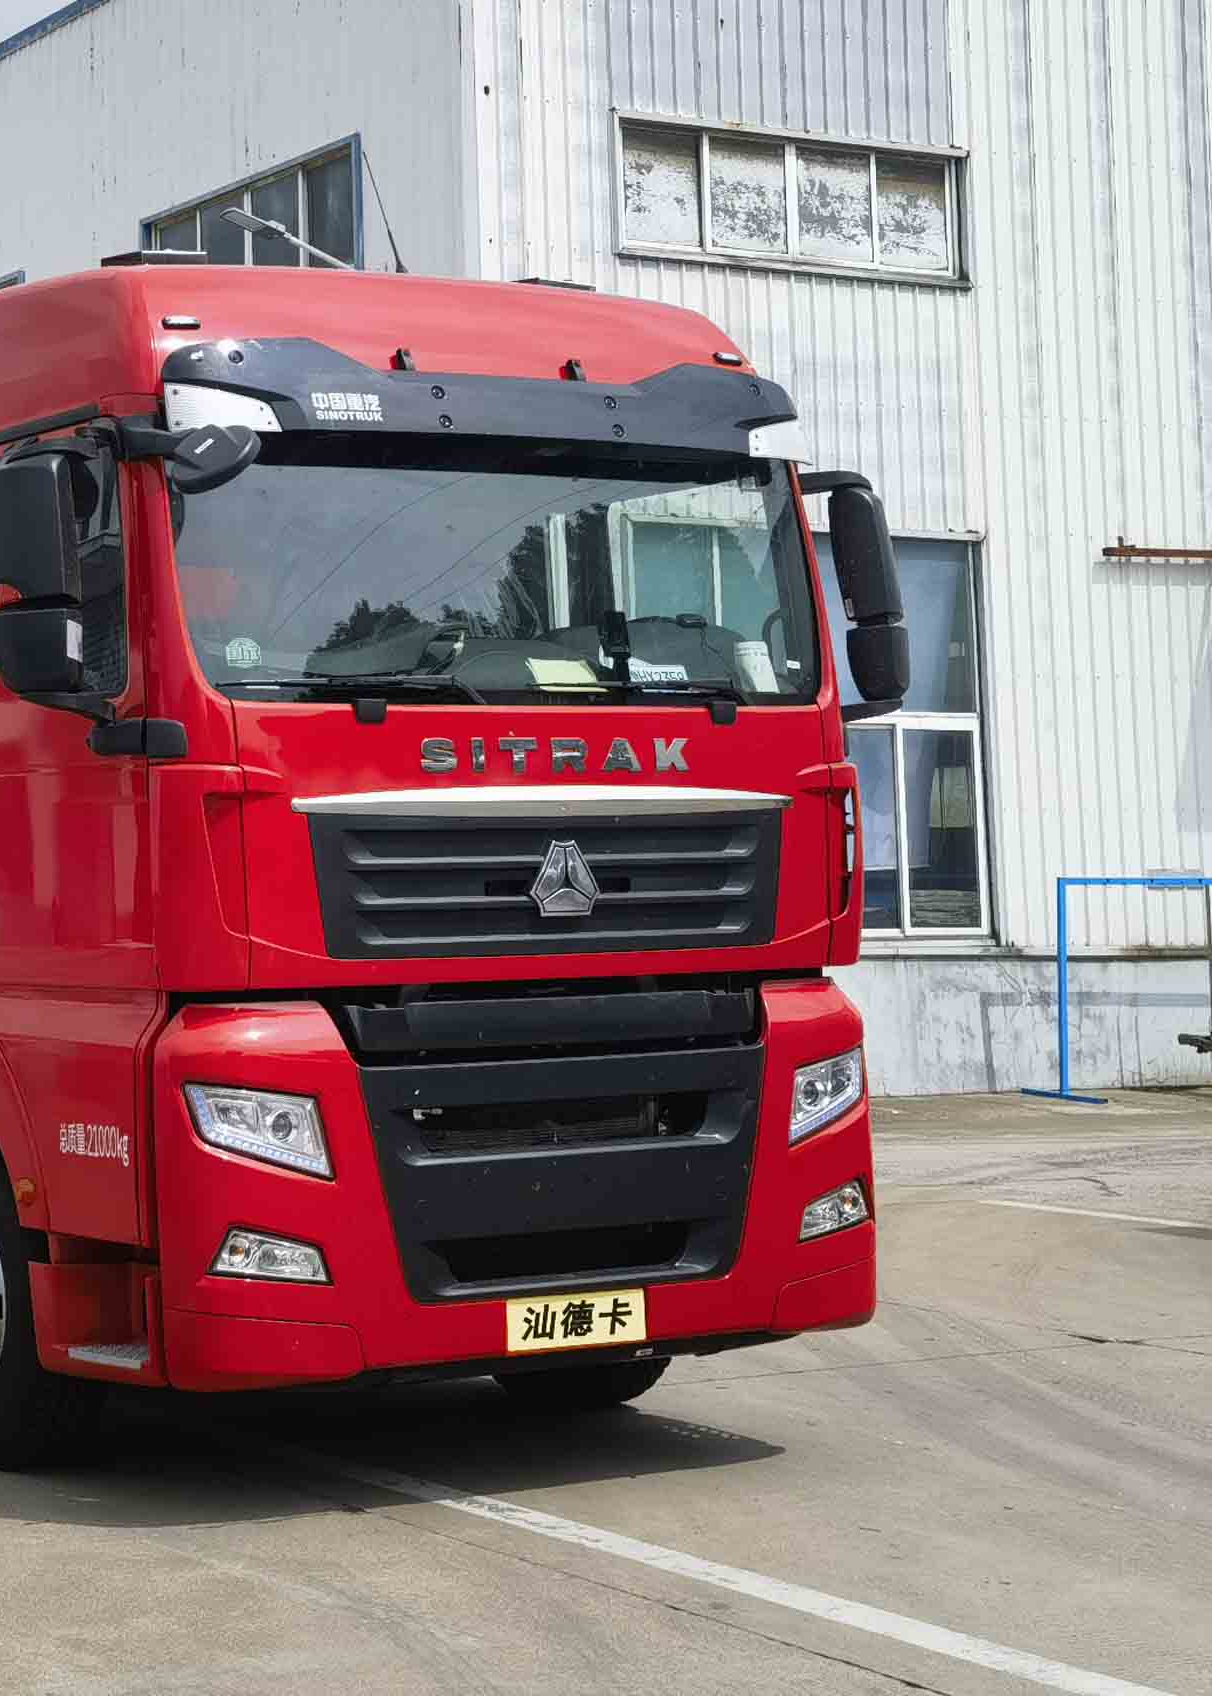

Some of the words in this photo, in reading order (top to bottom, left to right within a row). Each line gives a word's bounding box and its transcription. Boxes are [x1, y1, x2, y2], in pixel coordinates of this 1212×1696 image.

[315, 409, 384, 422] SINOTRUK
[420, 737, 690, 773] SITRAK
[521, 1298, 633, 1341] 汕德卡
